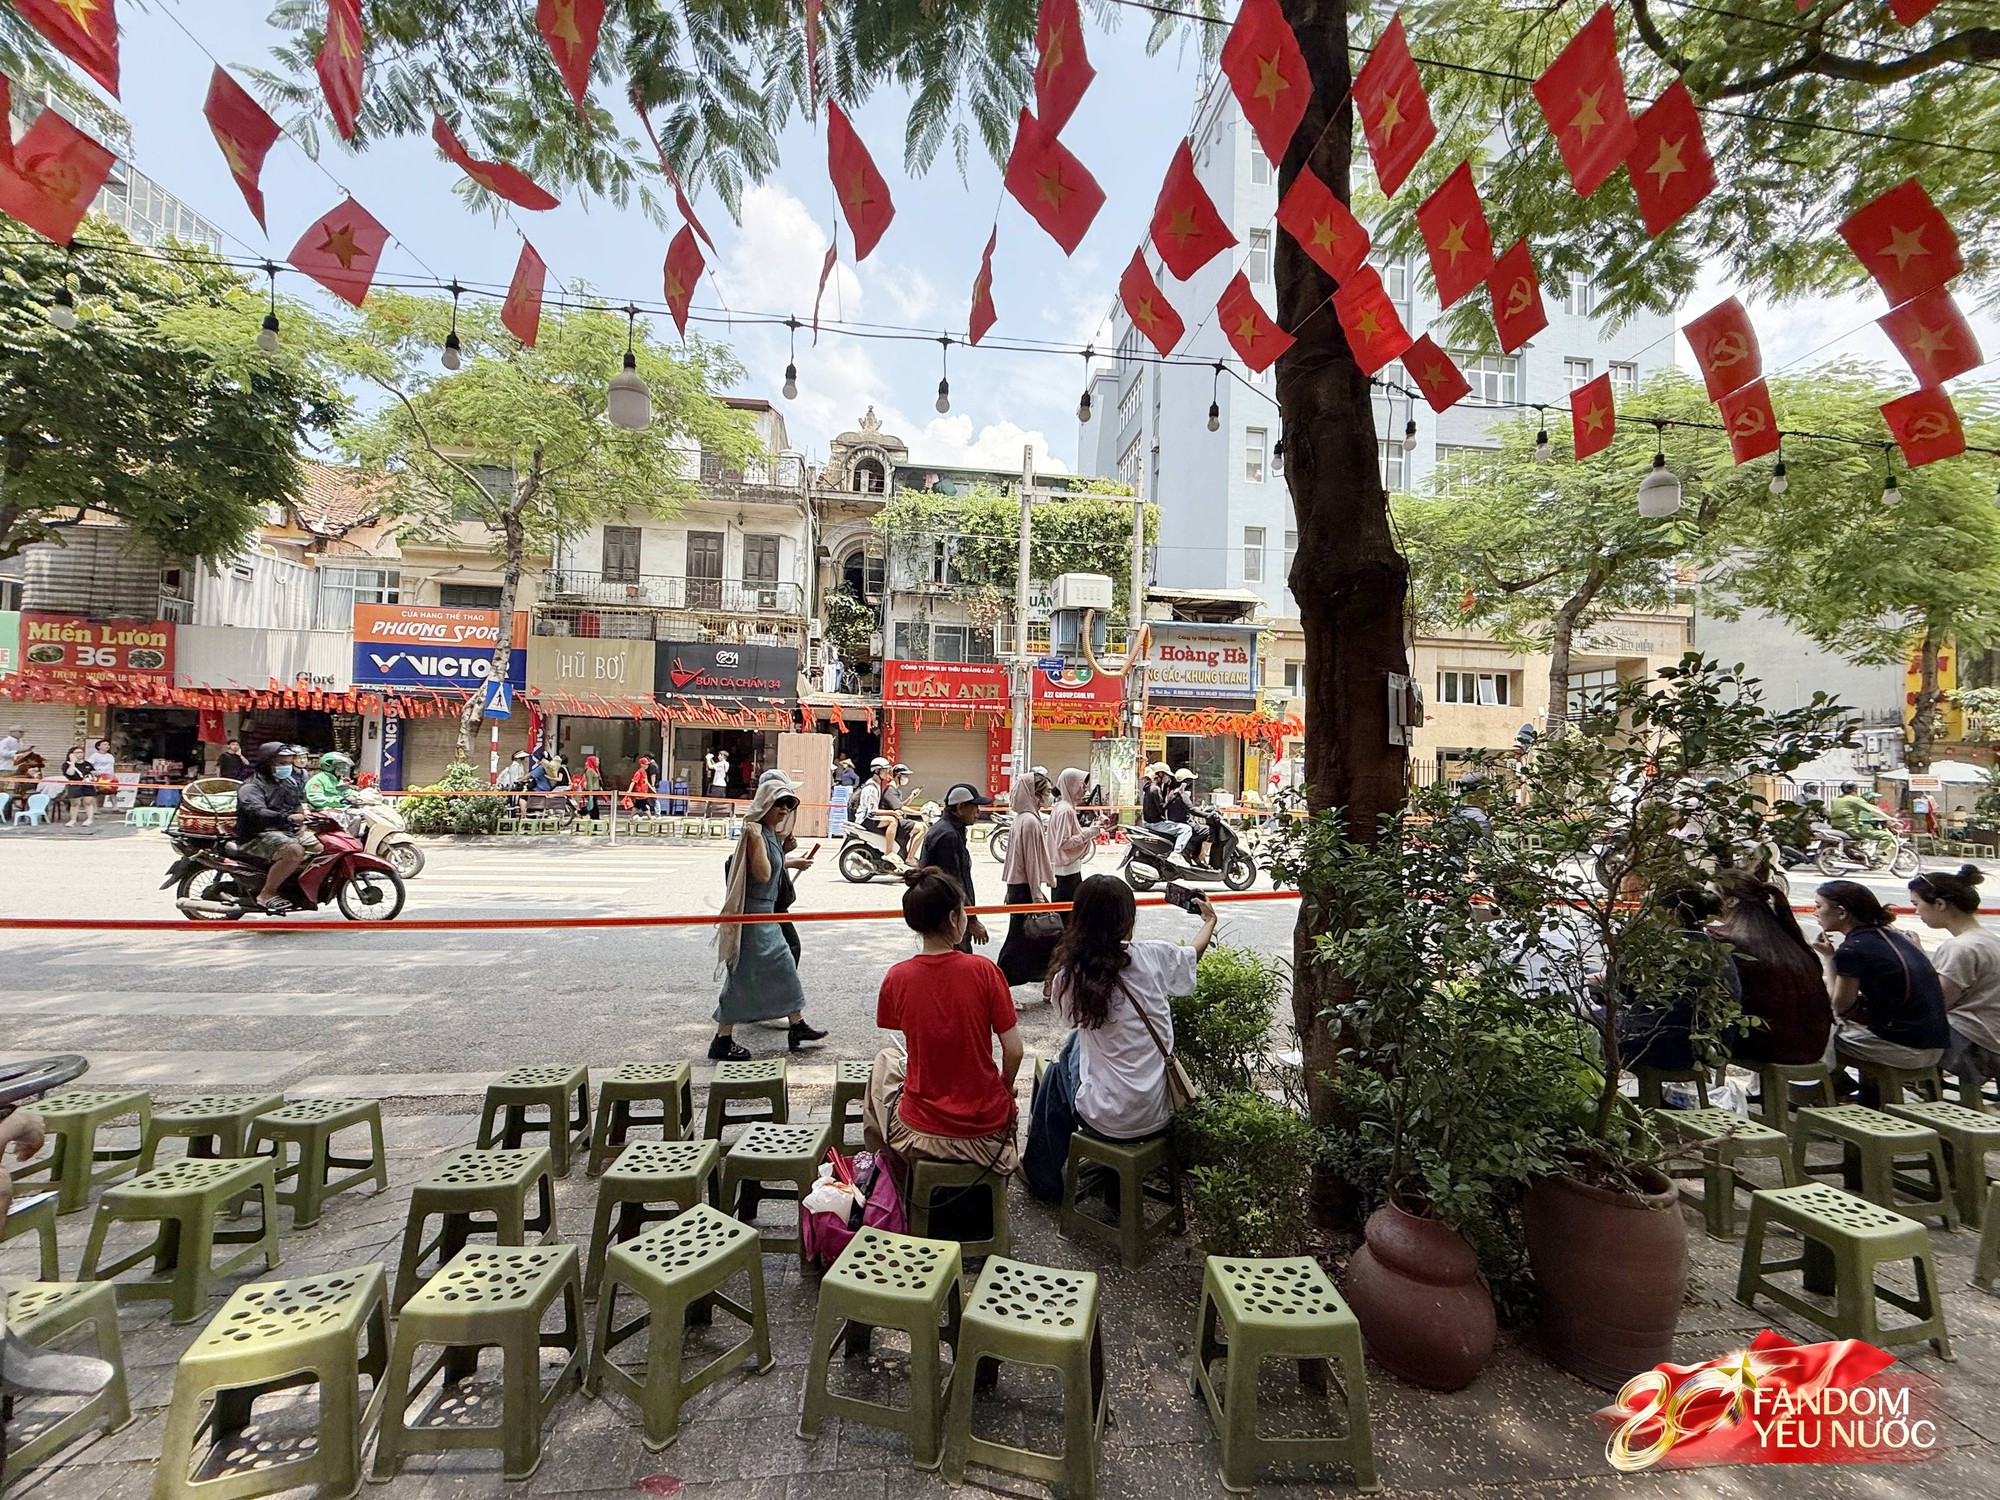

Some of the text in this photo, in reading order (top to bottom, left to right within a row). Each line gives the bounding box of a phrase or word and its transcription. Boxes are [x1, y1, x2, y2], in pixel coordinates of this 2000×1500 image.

[463, 613, 484, 622] THAO
[27, 620, 167, 647] Miến Lươn
[371, 620, 500, 643] PHƯƠNG SPOR
[75, 645, 117, 667] 36
[406, 655, 510, 679] VICTO
[1160, 645, 1248, 668] Hoàng Hà
[695, 674, 719, 687] BÚN
[719, 675, 735, 688] CÁ
[768, 680, 781, 689] 34
[893, 673, 1000, 699] TUẤN ANH
[1219, 671, 1249, 686] TRANH
